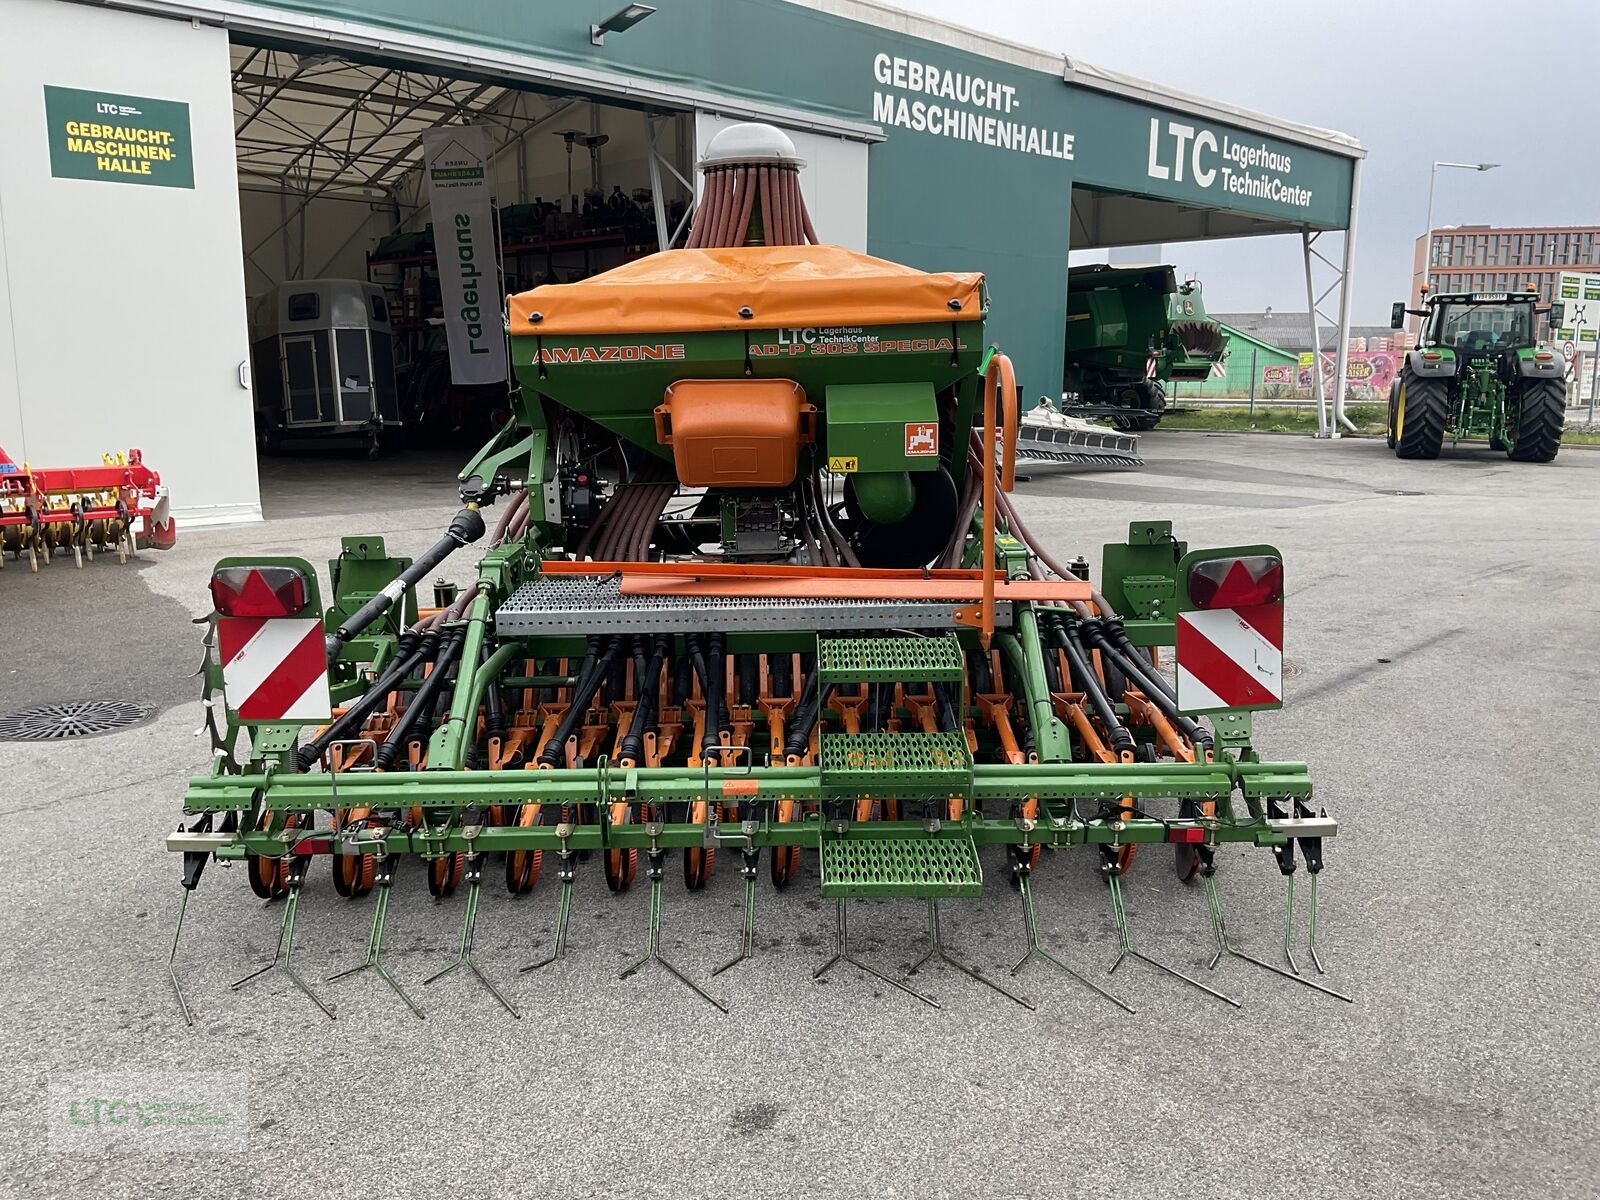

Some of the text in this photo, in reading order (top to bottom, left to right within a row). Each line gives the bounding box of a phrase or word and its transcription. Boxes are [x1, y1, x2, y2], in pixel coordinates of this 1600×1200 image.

[873, 53, 1020, 113] GEBRAUCHT-
[96, 102, 118, 115] LTC
[66, 121, 175, 145] GEBRAUCHT-
[873, 91, 1075, 160] MASCHINENHALLE
[67, 137, 176, 161] MASCHINEN-
[1148, 117, 1218, 188] LTC
[1222, 135, 1291, 173] Lagerhaus
[97, 156, 152, 175] HALLE
[1221, 167, 1312, 207] TechnikCenter
[748, 337, 968, 356] AD-P 303 SPECIAL
[778, 326, 863, 344] LTC Lagerhaus
[818, 334, 879, 343] TechnikCenter
[532, 344, 685, 364] AMAZONE
